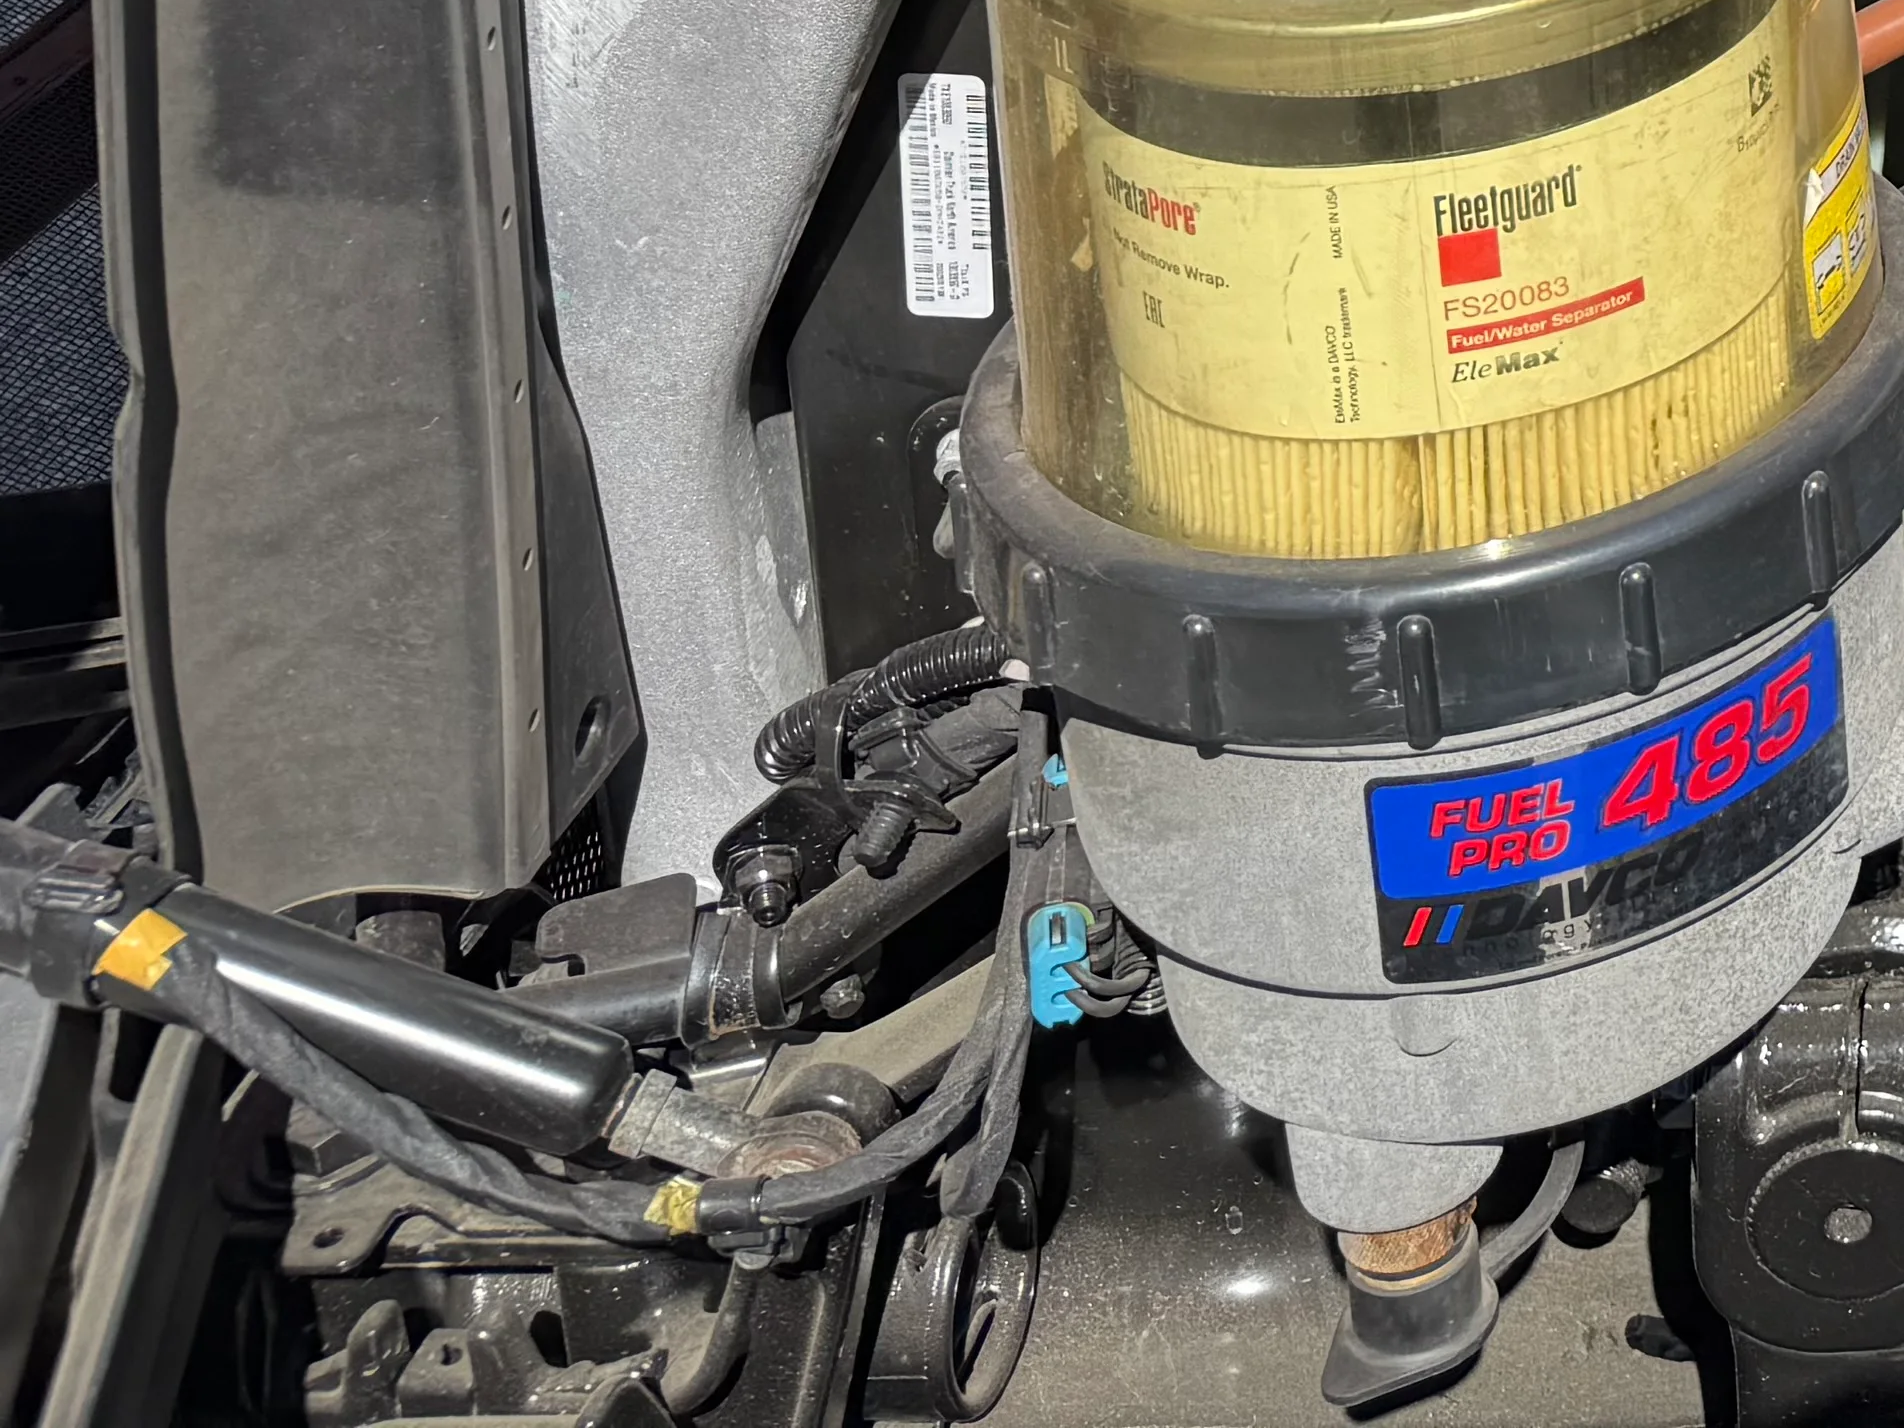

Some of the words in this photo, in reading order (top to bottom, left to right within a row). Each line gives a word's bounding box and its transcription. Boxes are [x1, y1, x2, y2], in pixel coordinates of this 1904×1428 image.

[1102, 160, 1197, 236] StrataPore
[1325, 185, 1339, 211] USA
[1328, 212, 1340, 225] IN
[1433, 163, 1578, 237] Fleetguard
[1132, 241, 1181, 275] Remove
[1183, 263, 1230, 290] Wrap.
[1329, 226, 1343, 259] MADE
[1443, 276, 1570, 322] FS20083
[1451, 320, 1548, 349] Fuel/Water
[1551, 290, 1633, 328] Separator
[1344, 340, 1355, 362] LLC
[1429, 777, 1576, 840] FUEL
[1600, 651, 1813, 830] 485
[1447, 818, 1571, 878] PRO
